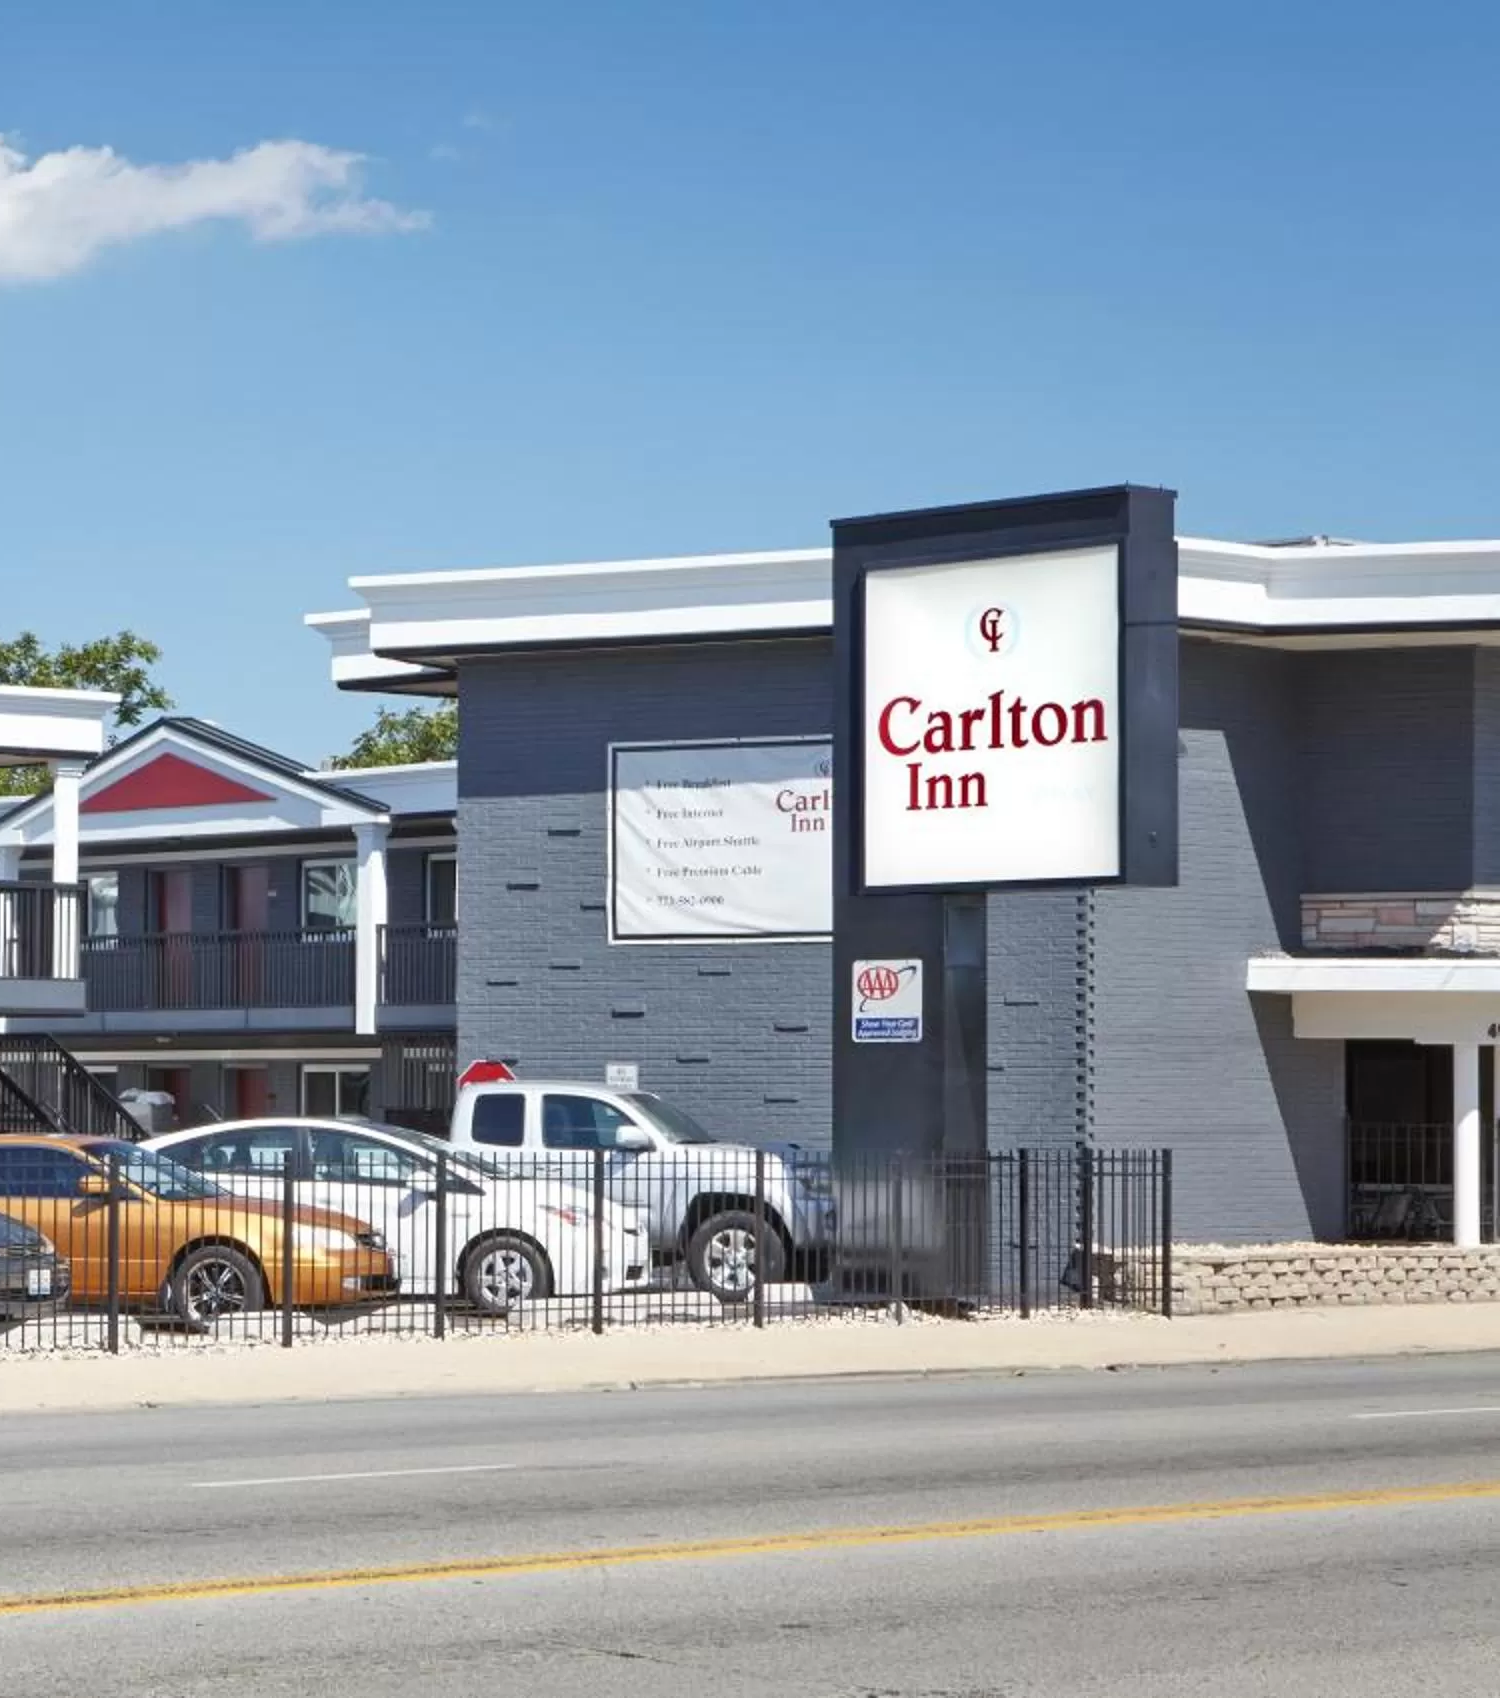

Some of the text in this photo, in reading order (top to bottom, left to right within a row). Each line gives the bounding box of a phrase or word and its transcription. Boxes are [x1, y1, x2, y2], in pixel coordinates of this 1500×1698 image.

[878, 689, 1108, 757] Carlton
[905, 761, 989, 811] Inn
[776, 788, 831, 813] Carl
[657, 809, 679, 819] Free
[790, 813, 826, 833] Inn
[657, 838, 678, 849] Free
[858, 967, 898, 999] AAA
